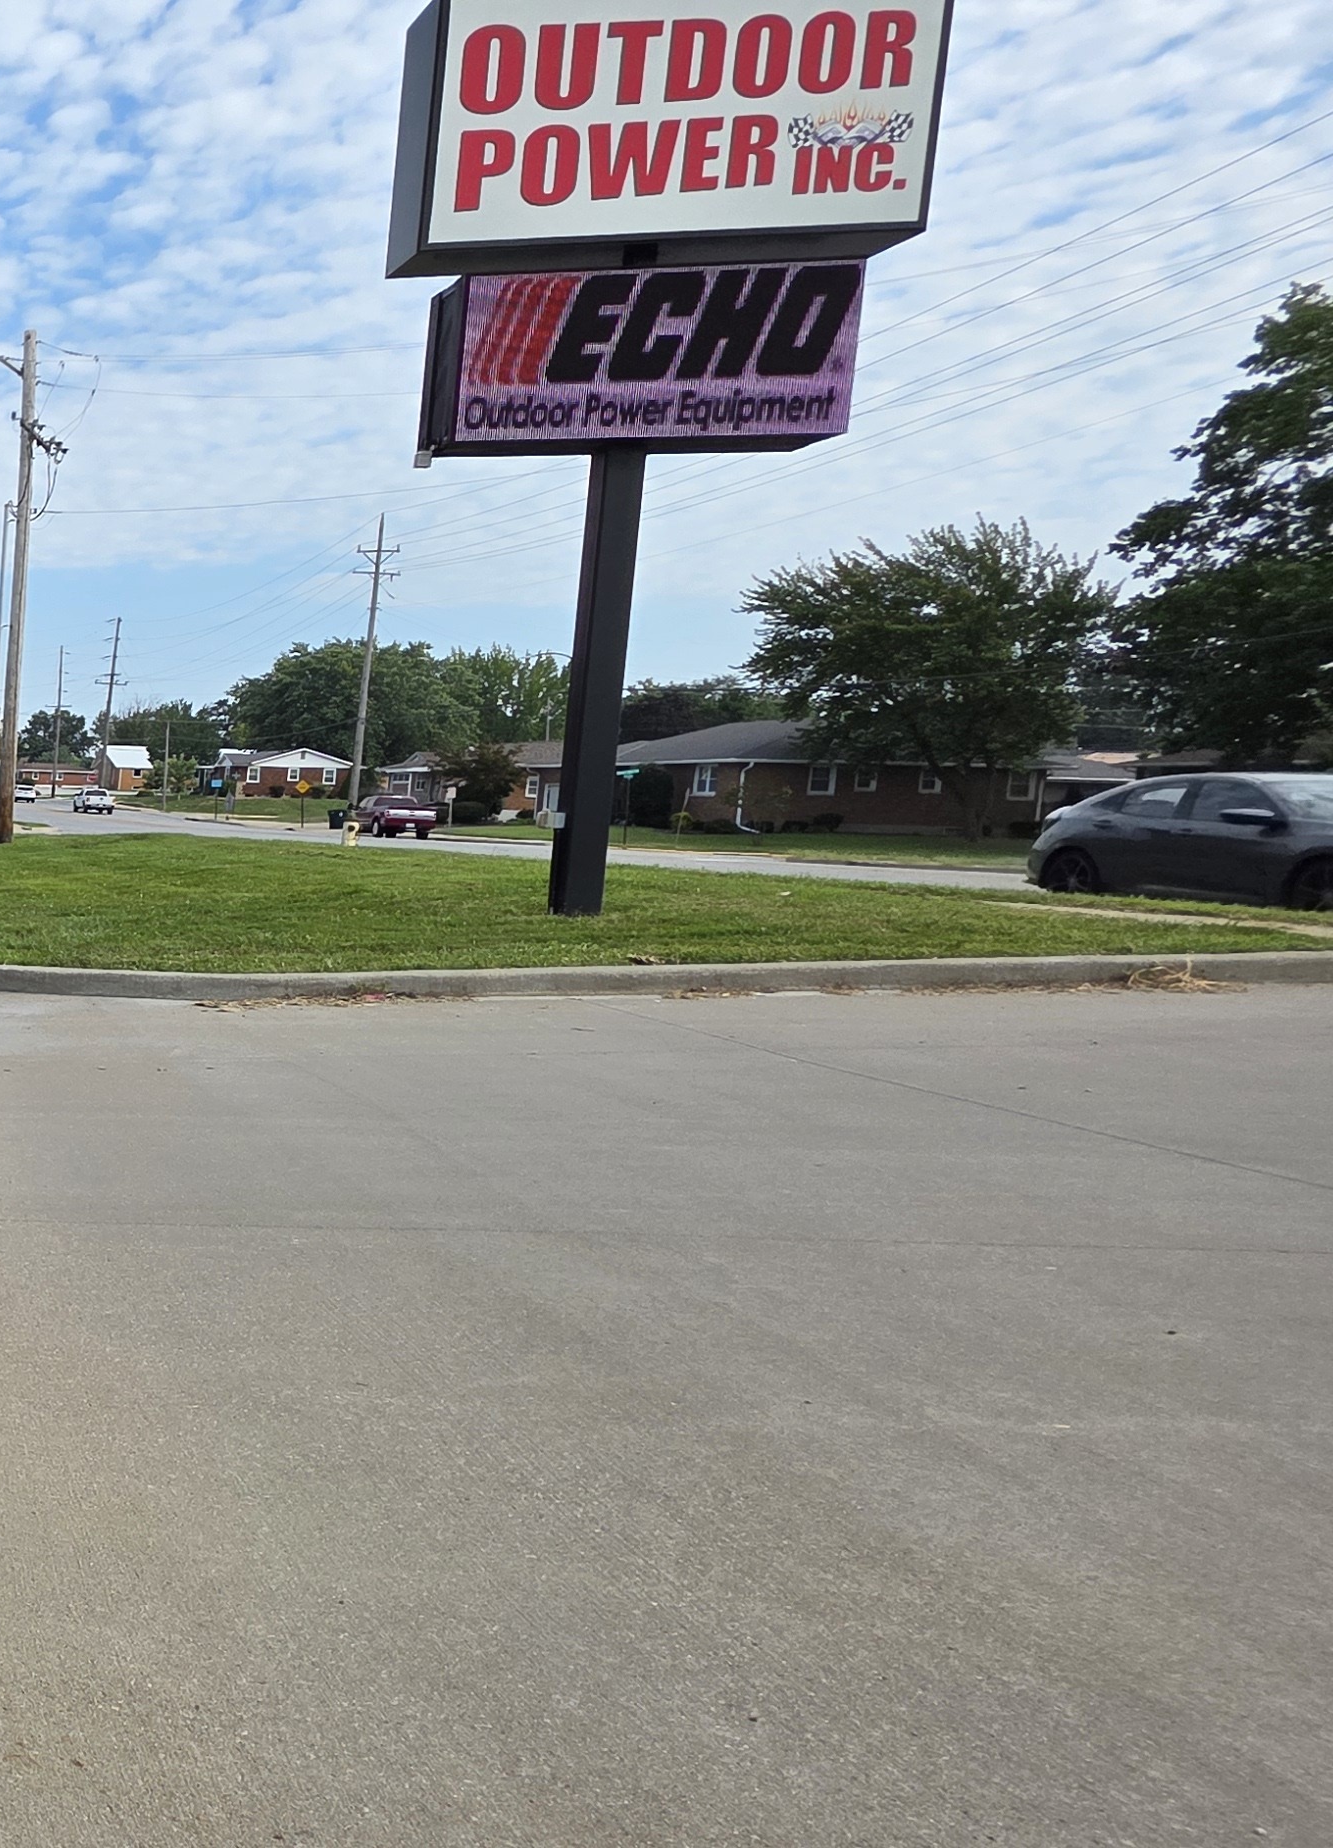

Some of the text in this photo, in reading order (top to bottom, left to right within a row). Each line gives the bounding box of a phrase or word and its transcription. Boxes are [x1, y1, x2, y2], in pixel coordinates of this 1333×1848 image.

[459, 10, 917, 115] OUTDOOR
[453, 114, 907, 212] POWER INC.
[544, 264, 863, 383] ECHO
[464, 385, 836, 431] Outdoor Power Equipment
